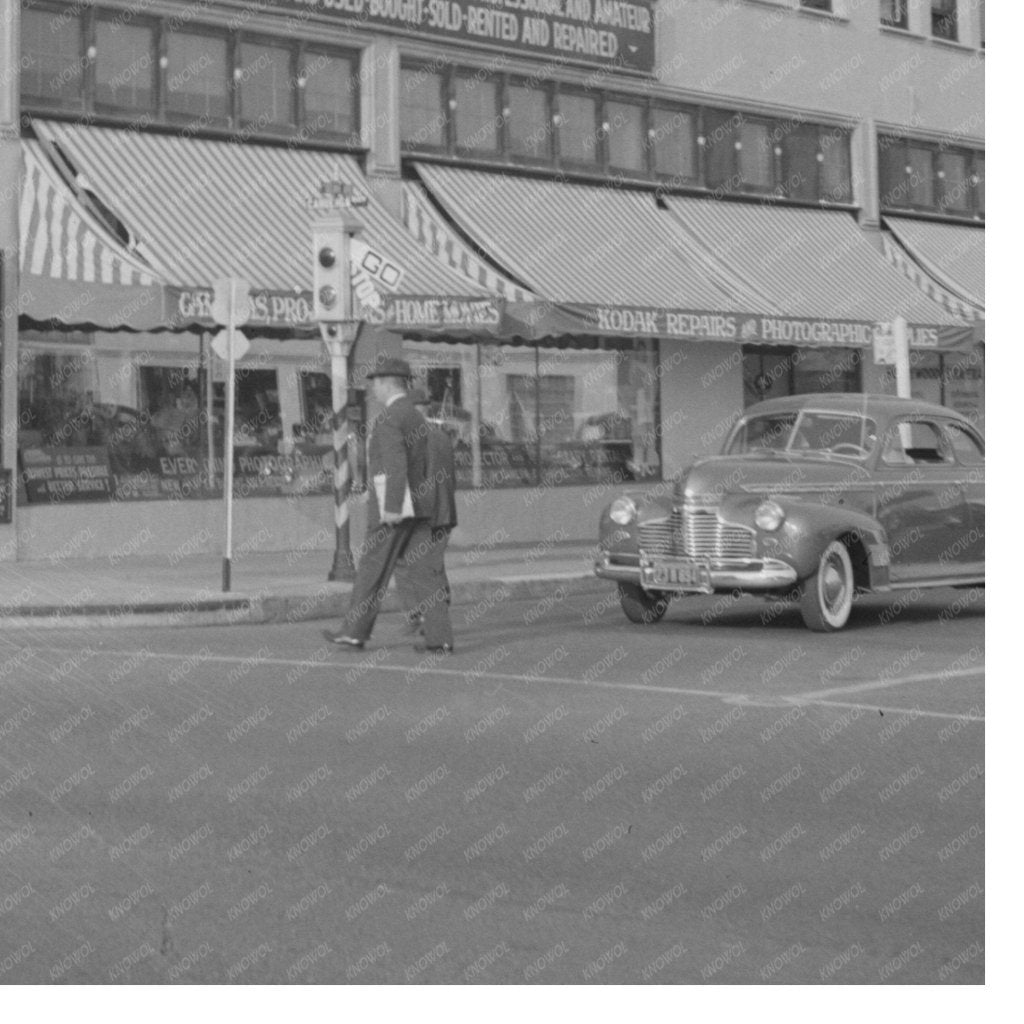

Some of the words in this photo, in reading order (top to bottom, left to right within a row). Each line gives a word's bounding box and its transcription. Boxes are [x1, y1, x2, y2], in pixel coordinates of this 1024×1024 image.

[522, 16, 550, 47] AND
[553, 21, 619, 58] REPAIRED
[361, 250, 401, 287] GO
[395, 299, 440, 324] HOME
[441, 300, 501, 325] MOVIES
[597, 308, 659, 333] KODAK
[666, 311, 738, 338] REPAIRS
[761, 317, 874, 344] PHOTOGRAPHIC
